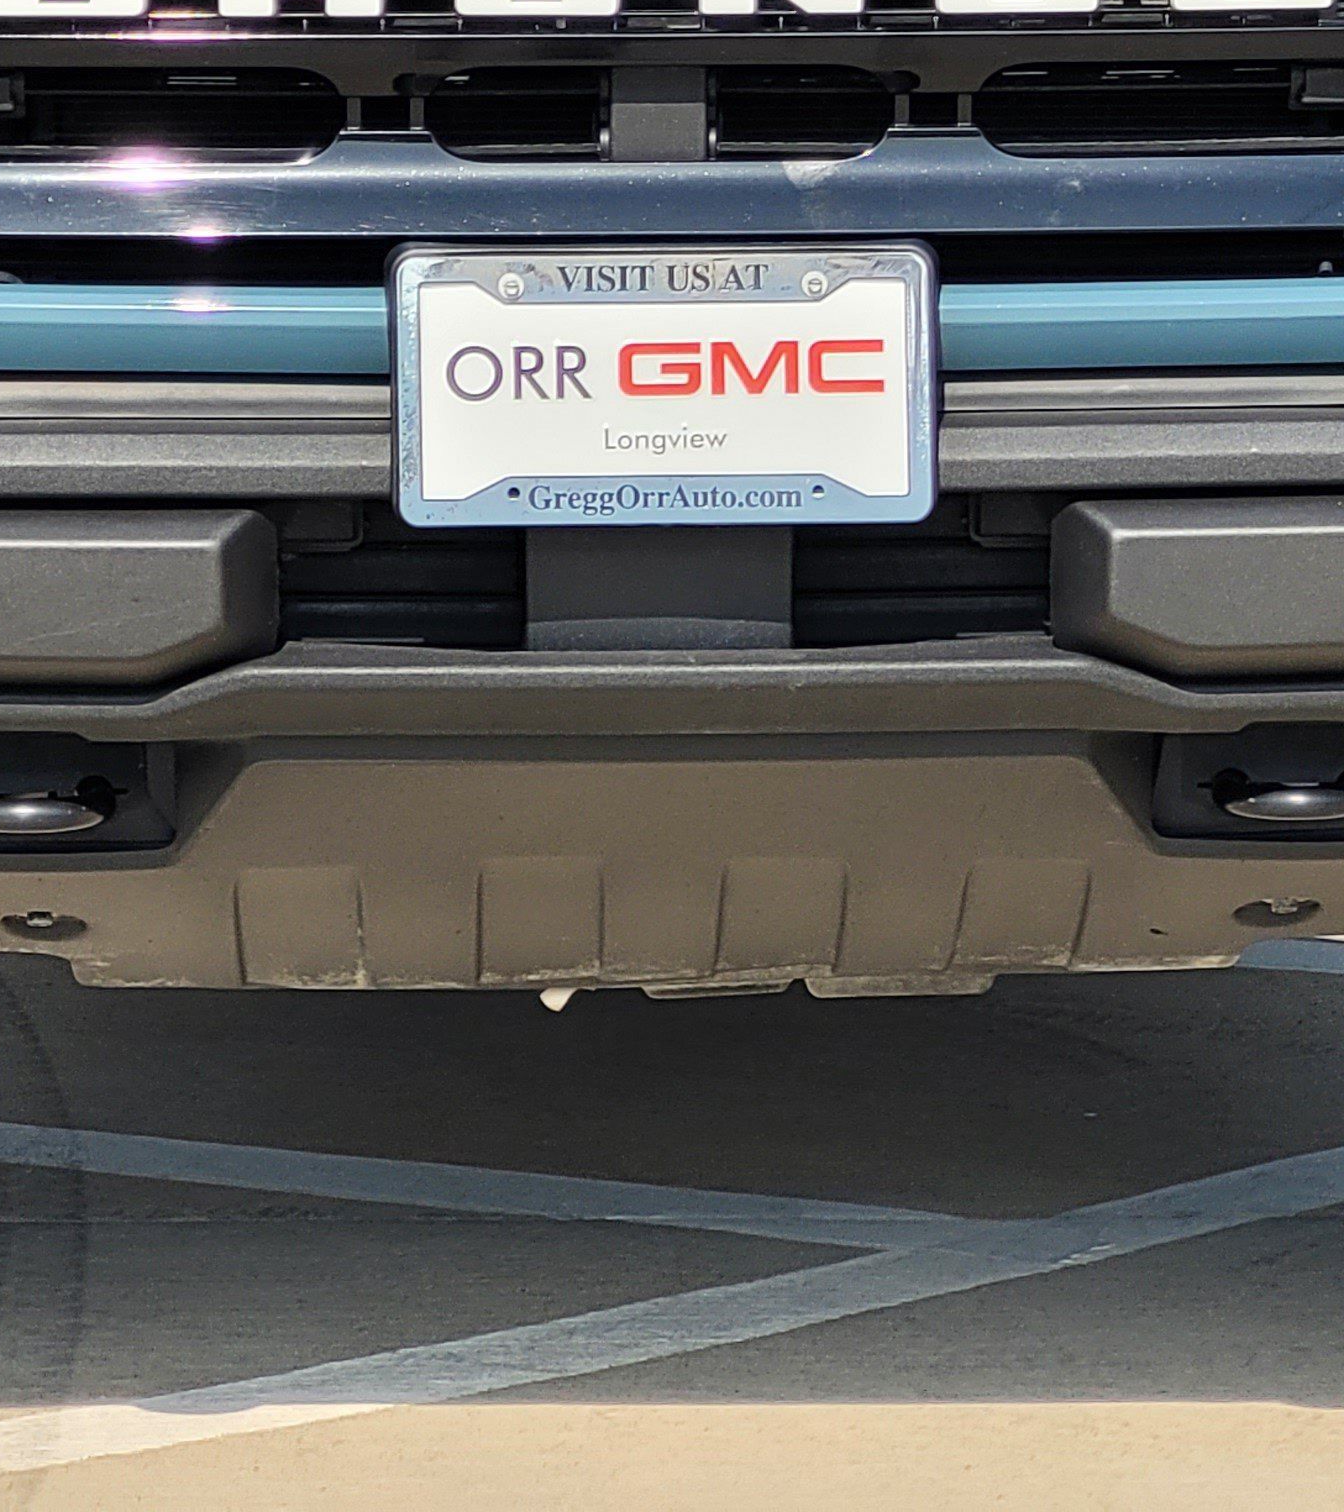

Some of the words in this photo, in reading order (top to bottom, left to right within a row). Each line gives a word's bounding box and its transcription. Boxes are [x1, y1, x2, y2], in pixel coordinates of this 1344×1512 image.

[557, 264, 655, 292] VISIT
[666, 264, 711, 292] US
[722, 263, 770, 291] AT
[446, 345, 593, 402] ORR
[618, 339, 885, 396] GMC
[603, 426, 728, 455] Longview
[528, 483, 803, 516] GreggOrrAuto.com
